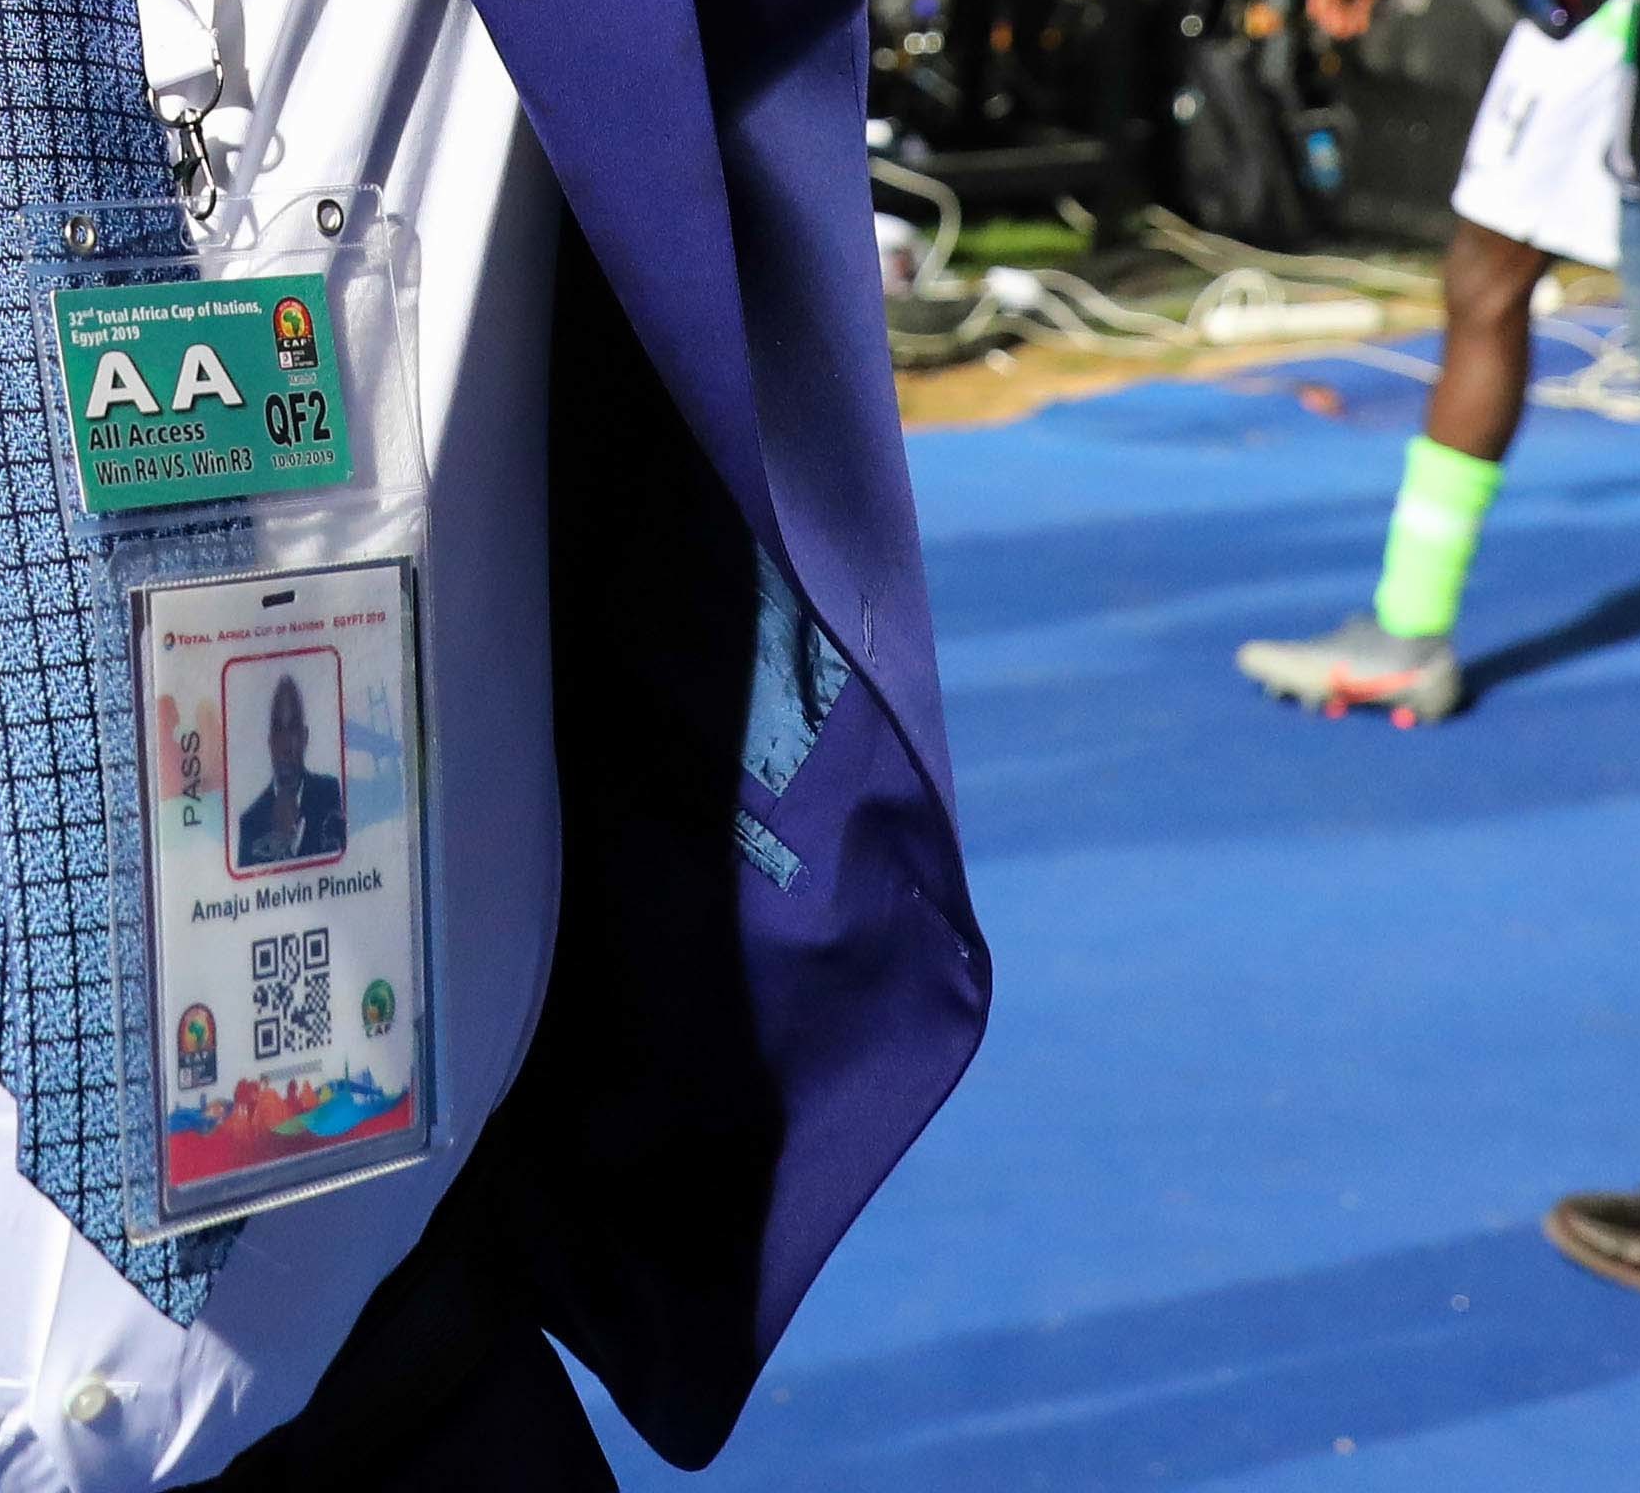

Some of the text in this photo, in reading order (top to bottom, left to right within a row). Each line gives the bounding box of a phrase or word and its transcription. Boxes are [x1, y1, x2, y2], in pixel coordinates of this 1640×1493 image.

[68, 307, 94, 327] 32nd
[97, 307, 129, 325] Total
[131, 305, 168, 323] Africa
[172, 304, 195, 322] Cup
[198, 301, 211, 317] of
[71, 325, 141, 347] Egypt 2019
[283, 338, 308, 348] CAF
[264, 389, 333, 450] QF2
[89, 421, 206, 452] All Access
[95, 447, 254, 486] Win R4 VS. Win R3
[272, 450, 335, 470] 10.07.2019
[177, 635, 212, 646] TOTAL
[333, 613, 364, 627] EGYPT
[180, 731, 203, 828] PASS
[191, 868, 383, 923] Amaju Melvin Pinnick
